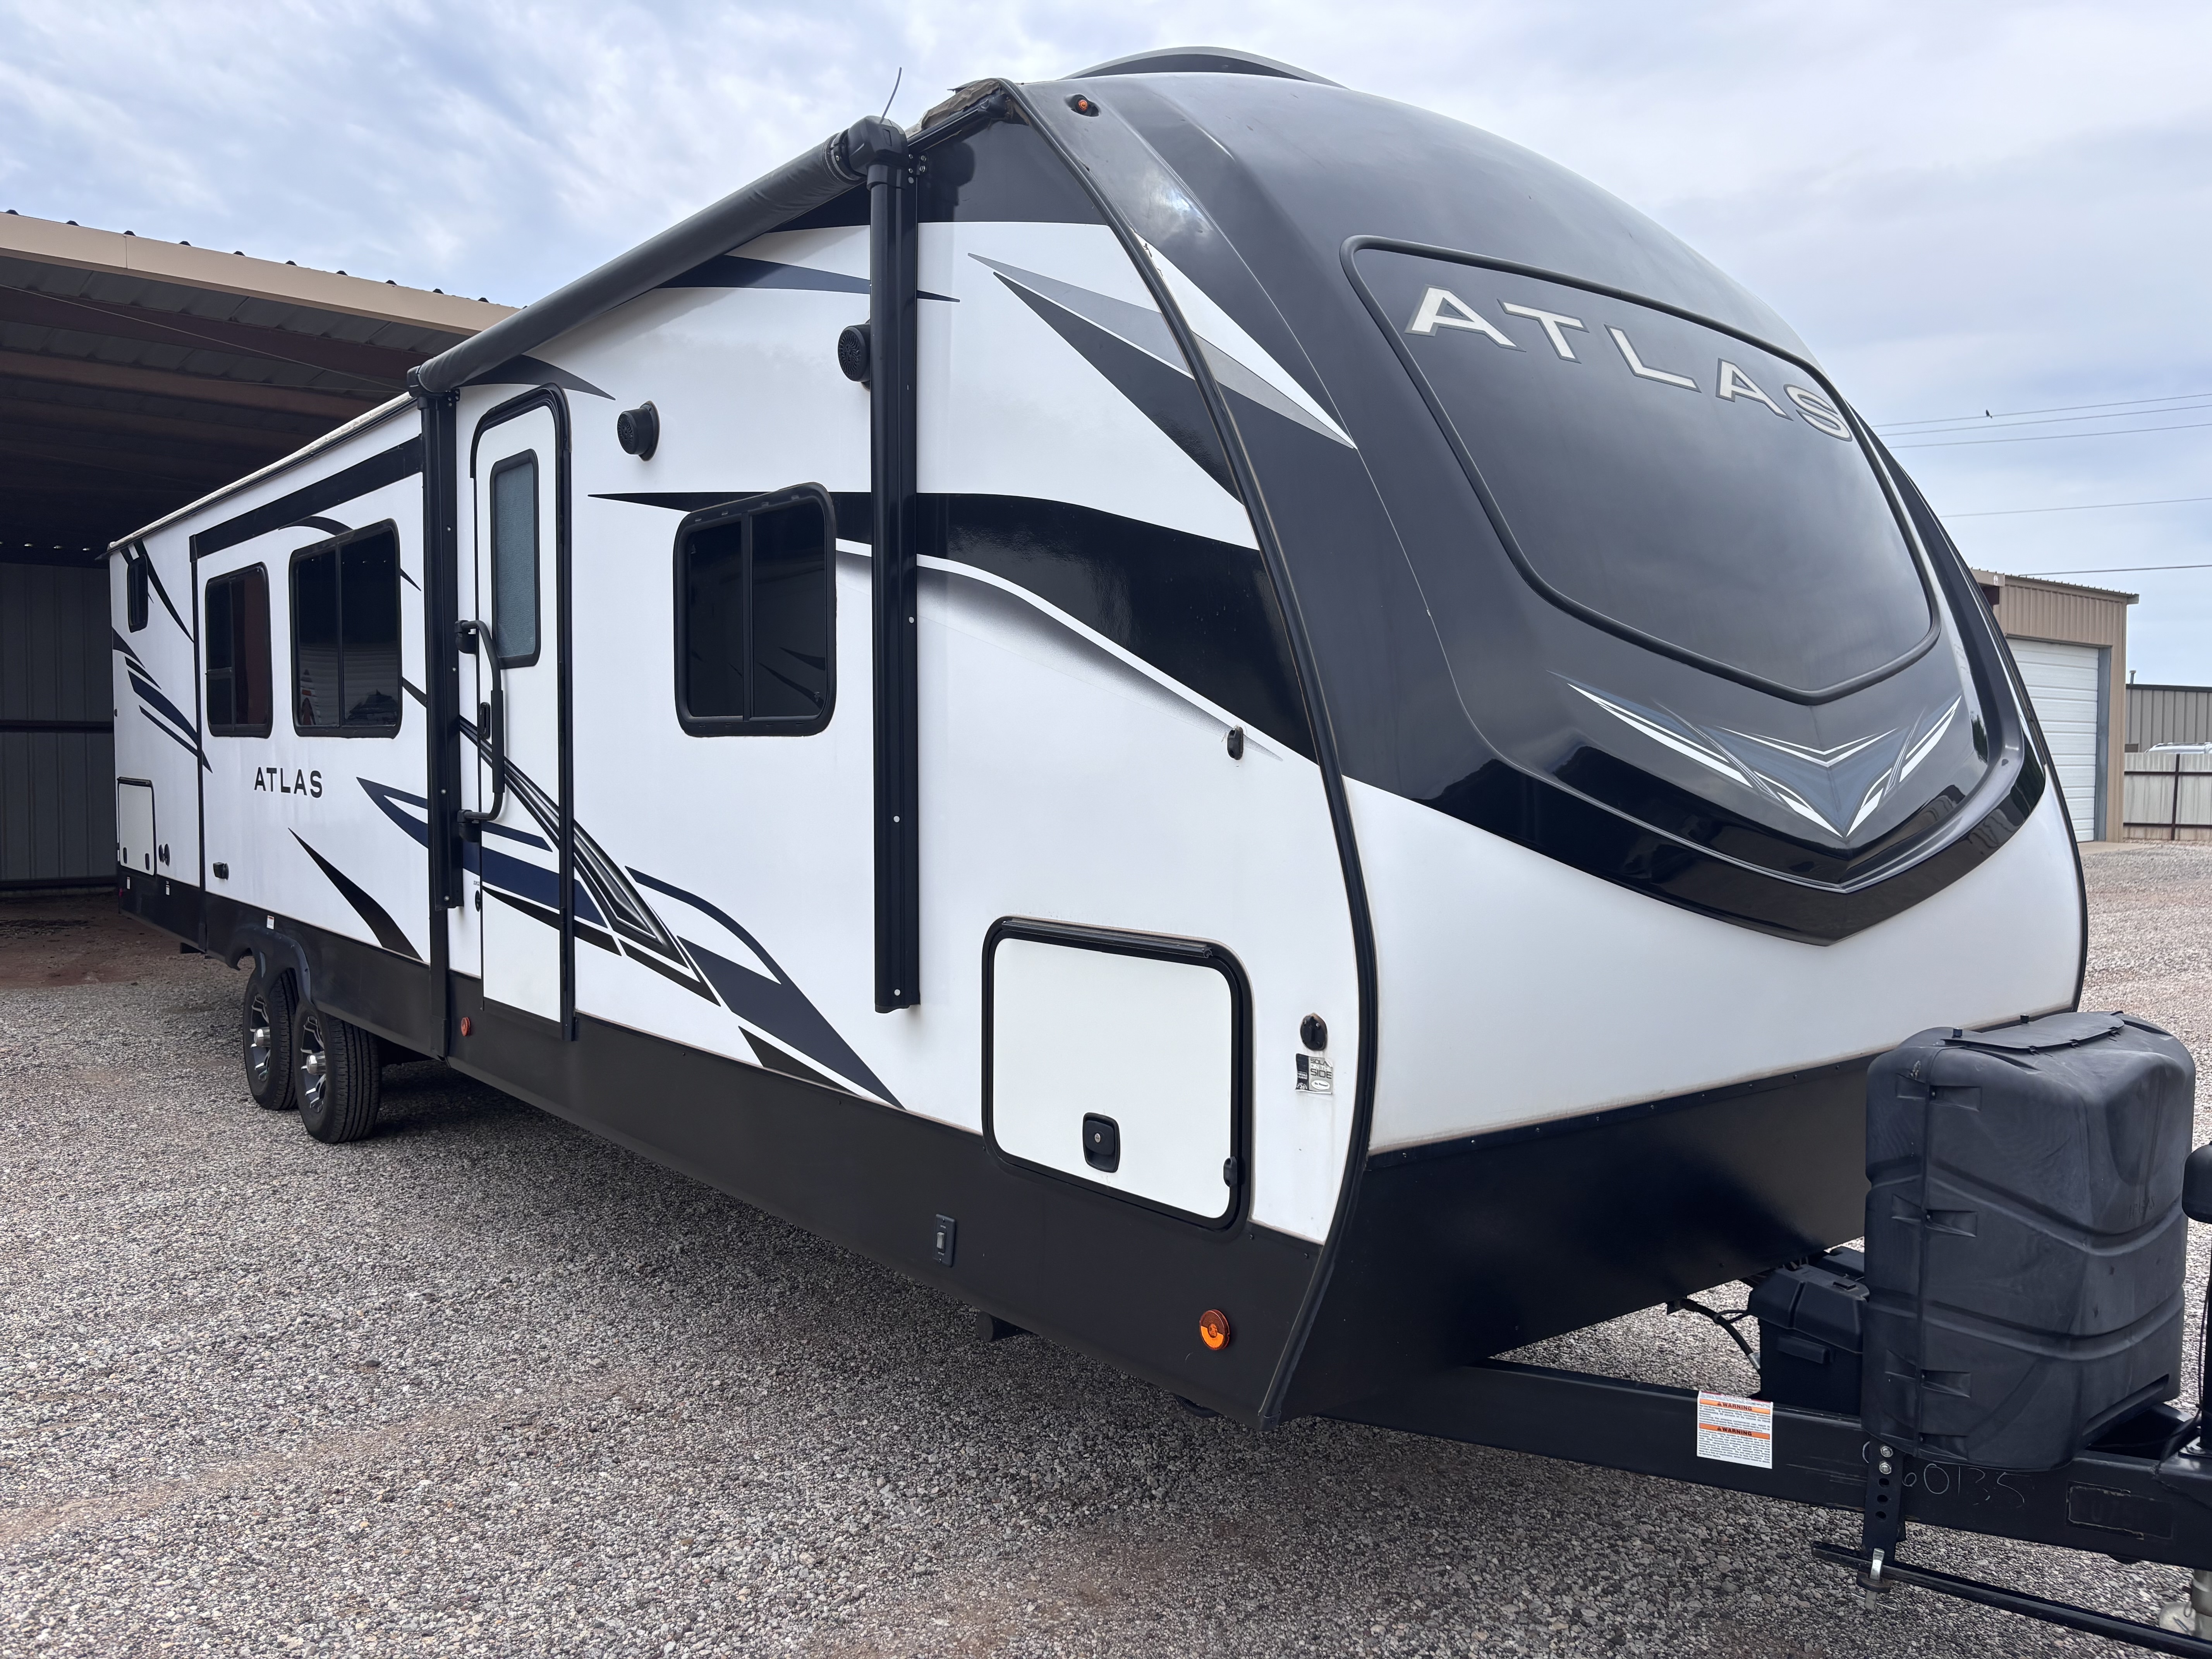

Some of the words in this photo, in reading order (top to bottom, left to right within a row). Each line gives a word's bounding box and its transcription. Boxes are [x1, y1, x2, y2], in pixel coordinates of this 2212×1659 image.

[1406, 285, 1852, 441] ATLAS
[254, 767, 323, 798] ATLAS
[1310, 1058, 1328, 1066] SOLA
[1310, 1068, 1332, 1079] SIDE
[1723, 1402, 1752, 1411] WARNING
[1723, 1427, 1752, 1436] WARNING
